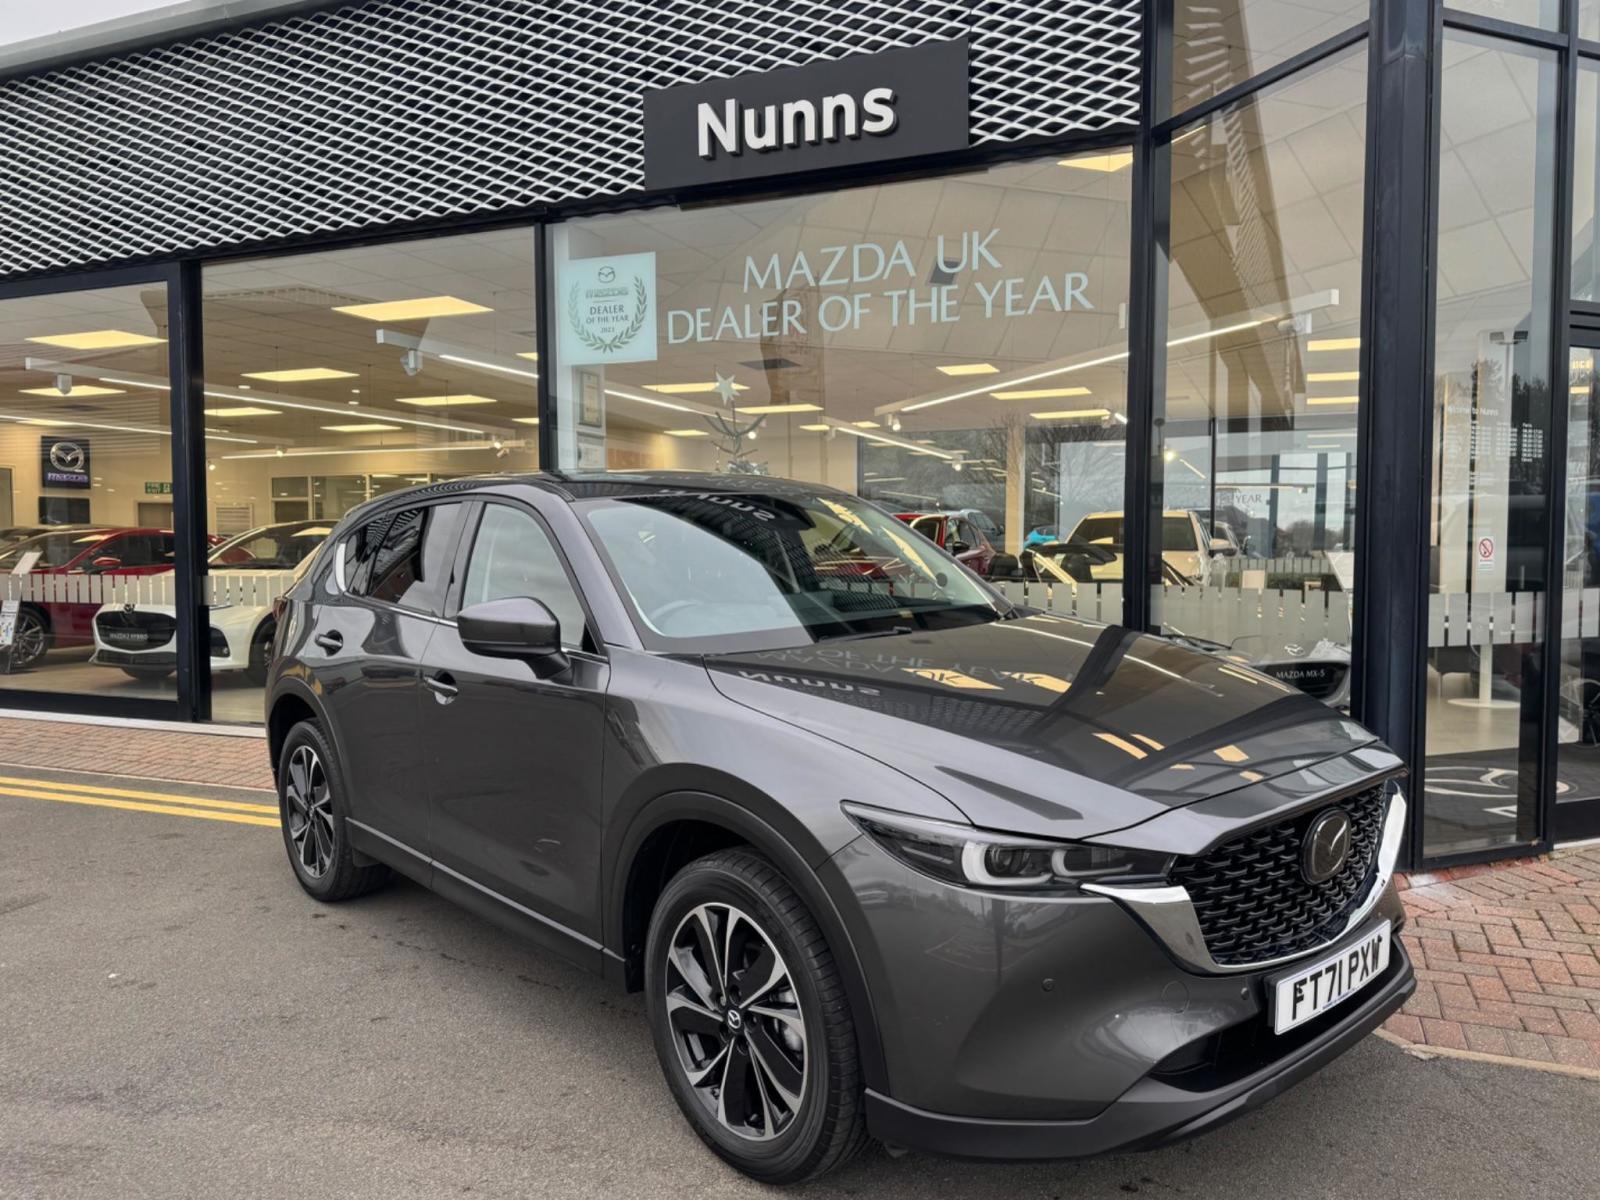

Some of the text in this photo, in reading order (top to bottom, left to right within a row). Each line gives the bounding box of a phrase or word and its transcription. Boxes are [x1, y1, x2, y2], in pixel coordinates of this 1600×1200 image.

[698, 88, 896, 158] Nunns
[743, 228, 1002, 293] MAZDA UK
[590, 304, 624, 315] DEALER
[597, 315, 609, 324] THE
[612, 314, 629, 322] YEAR
[668, 272, 1095, 344] DEALER OF THE YEAR
[1275, 668, 1325, 680] MAZDA MX-5
[1292, 959, 1342, 1020] FT71
[1347, 934, 1383, 990] PXW
